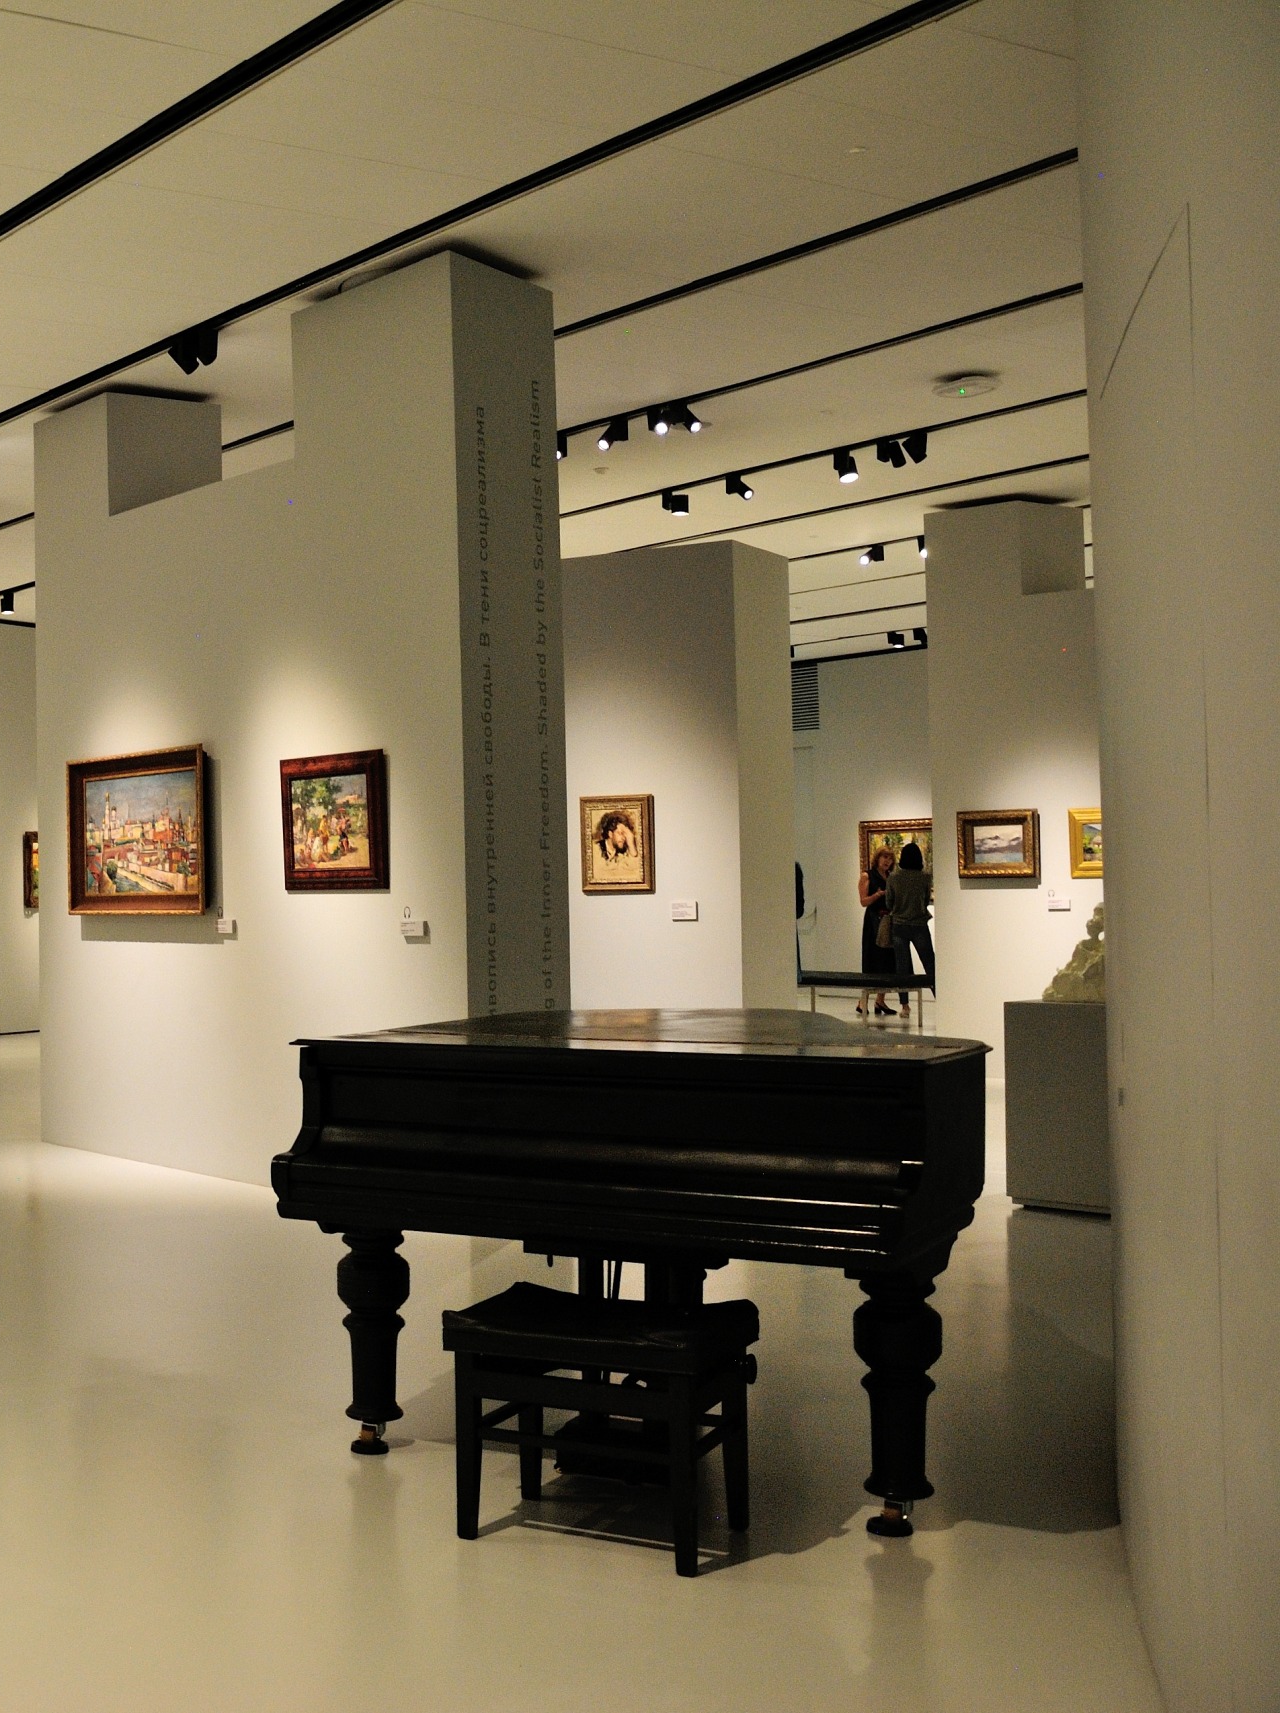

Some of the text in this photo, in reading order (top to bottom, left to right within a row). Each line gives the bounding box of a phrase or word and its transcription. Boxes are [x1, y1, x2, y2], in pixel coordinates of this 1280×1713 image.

[530, 380, 541, 469] Realism
[532, 477, 544, 571] Socialist
[534, 579, 545, 613] the
[536, 621, 548, 646] by
[476, 406, 498, 1016] ивопись внутренней свободы. В тени соцреализма
[536, 653, 548, 736] Shaded
[539, 744, 550, 850] Freedom.
[541, 859, 551, 918] Inner
[541, 926, 551, 961] the
[541, 970, 551, 990] of
